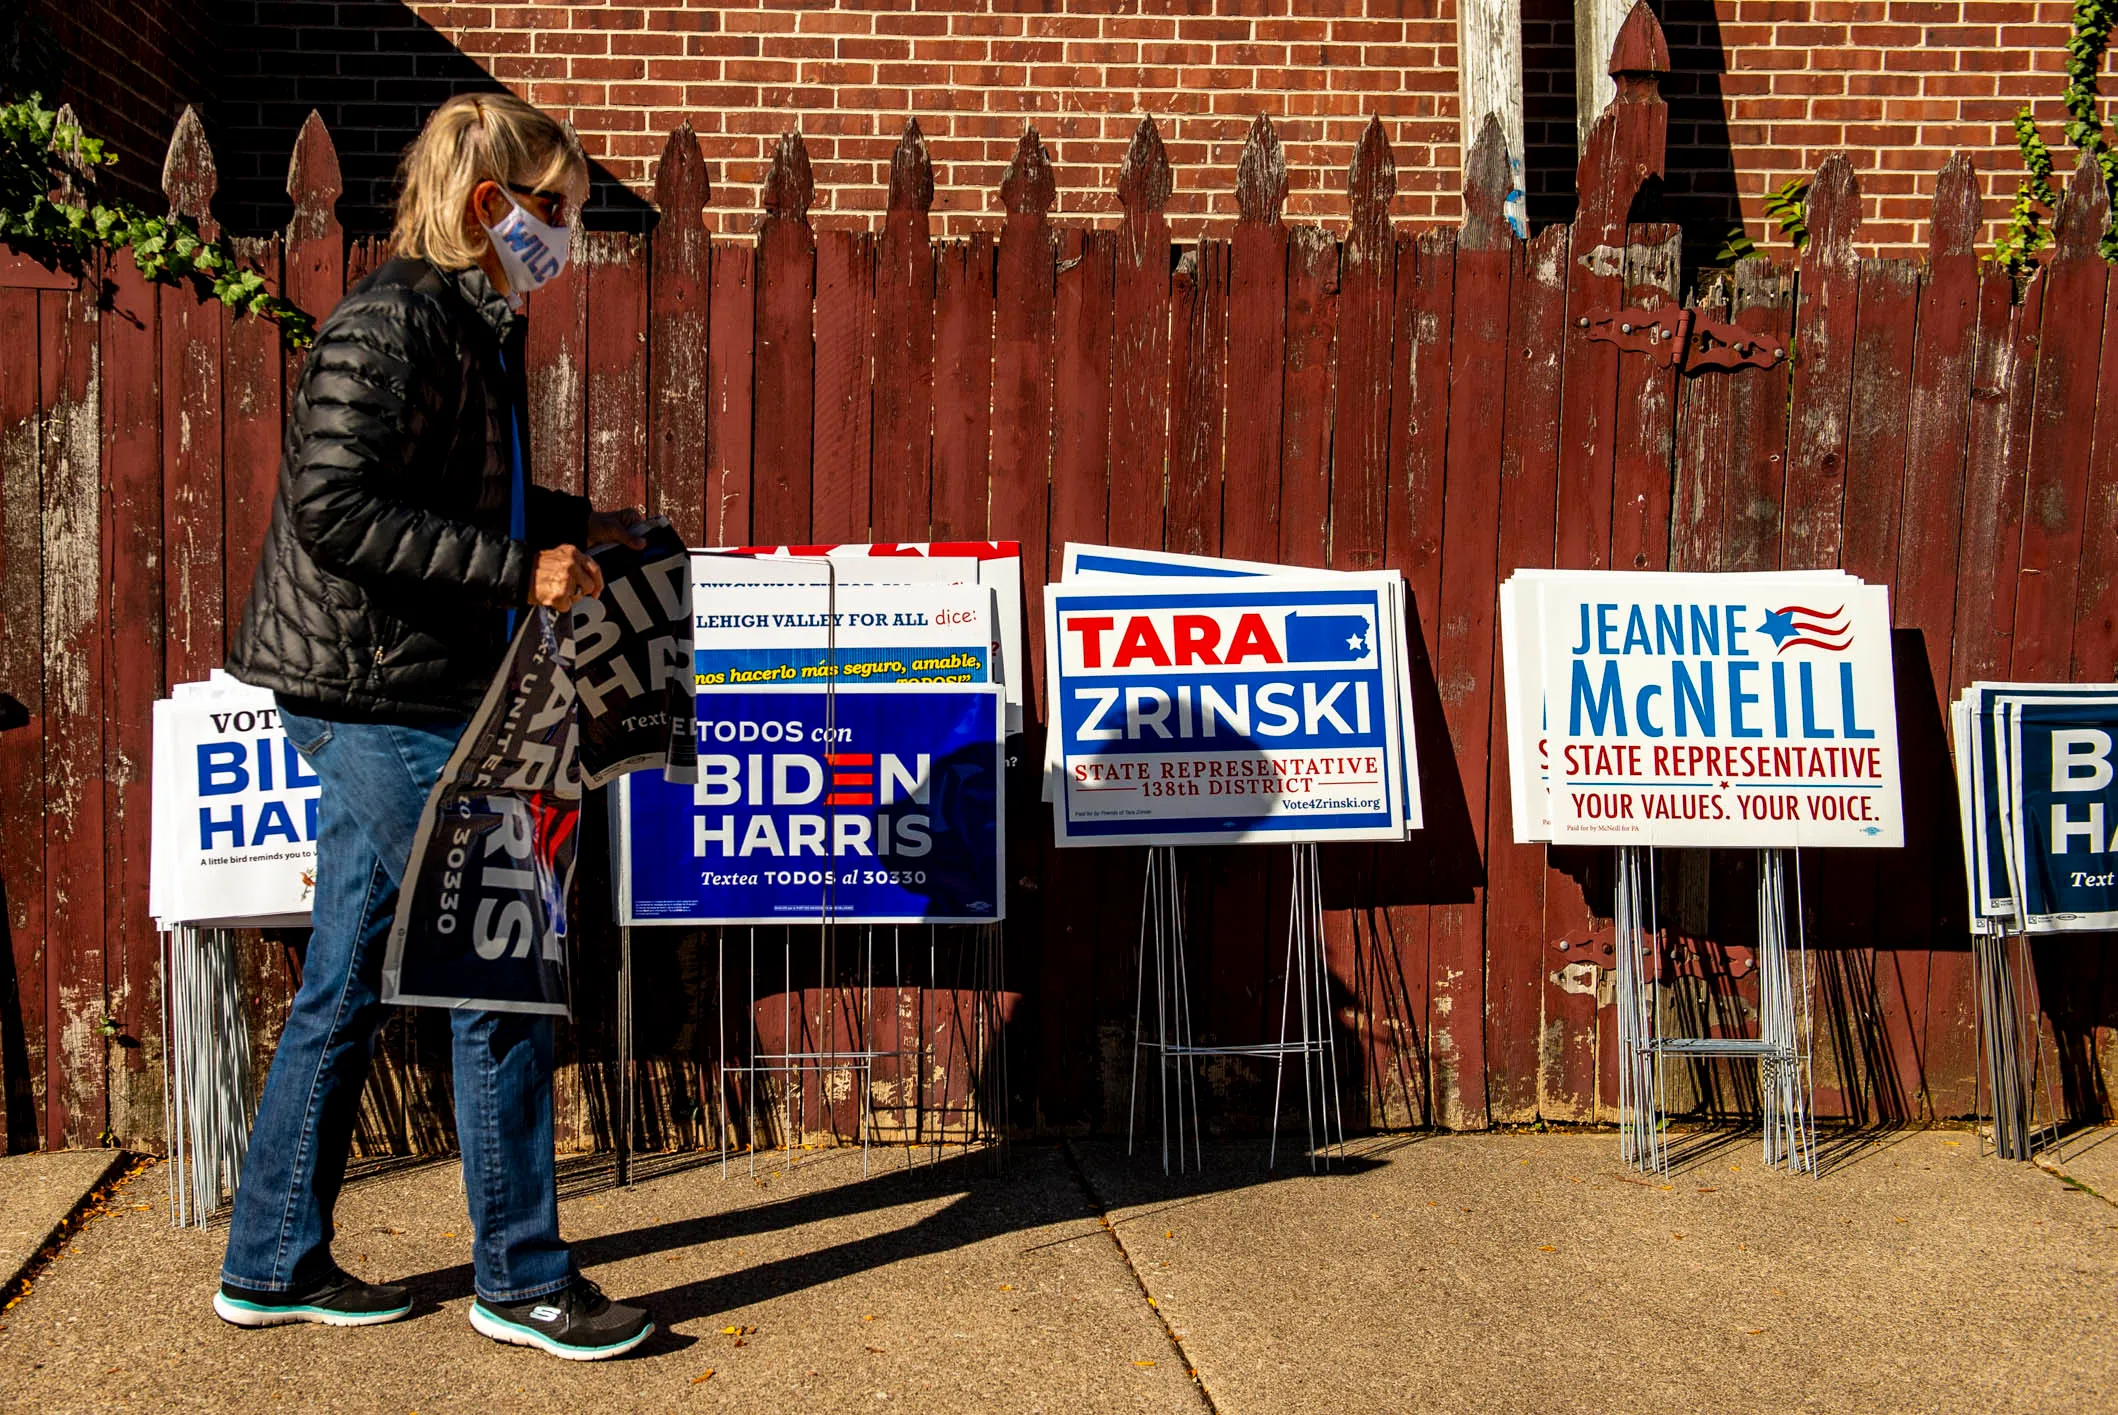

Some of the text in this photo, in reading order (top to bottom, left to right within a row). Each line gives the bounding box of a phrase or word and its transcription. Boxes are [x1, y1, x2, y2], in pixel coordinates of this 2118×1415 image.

[696, 609, 977, 629] LEHIGH VALLEY FOR ALL dice:
[1572, 603, 1749, 656] JEANNE
[1067, 613, 1283, 668] TARA
[730, 665, 796, 683] hacerlo
[801, 659, 839, 678] más
[843, 659, 907, 676] seguro,
[911, 653, 982, 671] amable,
[1074, 681, 1371, 741] ZRINSKI
[1569, 660, 1875, 739] McNEILL
[621, 711, 667, 732] Text
[697, 720, 853, 743] TODOS con
[1074, 757, 1378, 782] STATE REPRESENTATIVE
[1563, 744, 1642, 776] STATE
[1654, 745, 1882, 779] REPRESENTATIVE
[694, 753, 930, 806] BIDEN
[1142, 777, 1313, 797] 138th DISTRICT
[1282, 797, 1381, 811] Vote4Zrinski.org
[1571, 793, 1880, 822] YOUR VALUES. YOUR VOICE.
[694, 814, 933, 857] HARRIS
[1590, 825, 1597, 833] by
[208, 857, 228, 865] little
[230, 855, 247, 864] bird
[249, 853, 283, 862] reminds
[285, 852, 301, 861] you
[437, 828, 471, 934] 30330
[701, 869, 927, 886] Textea TODOS al 30330
[2070, 872, 2115, 887] Text
